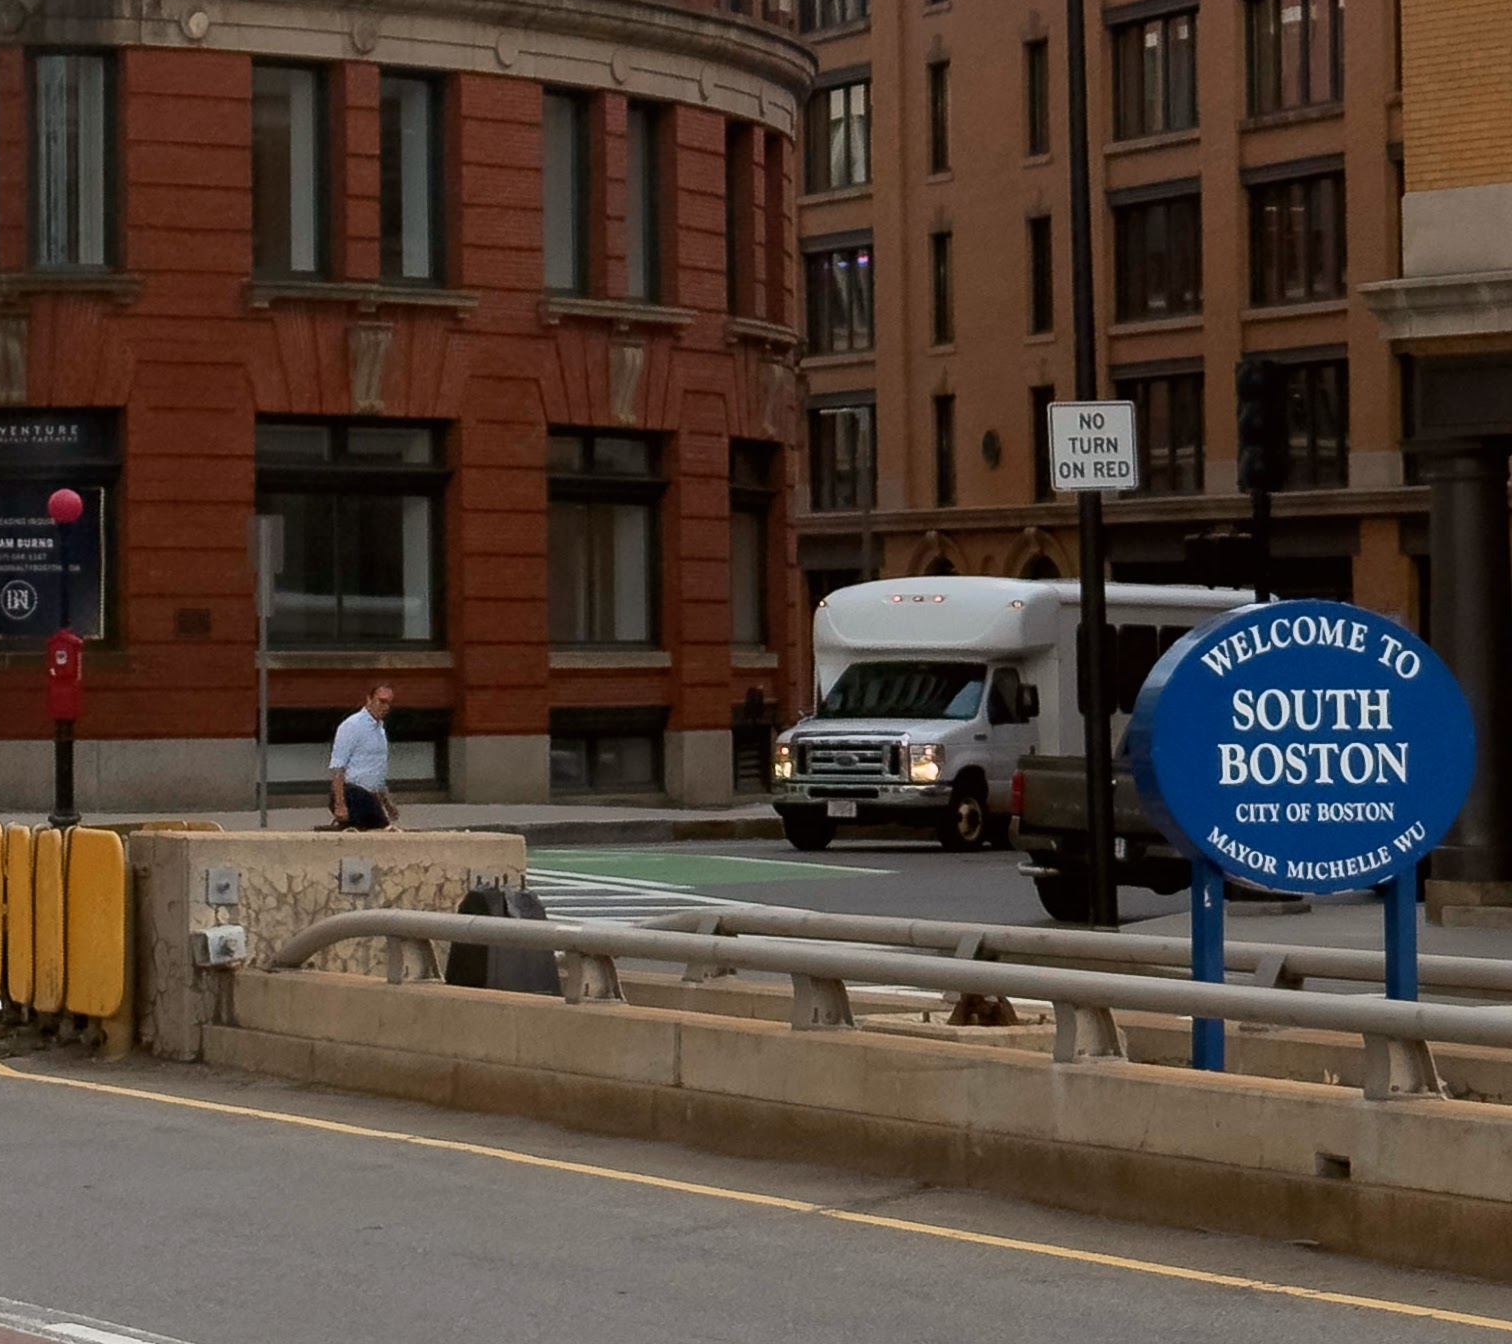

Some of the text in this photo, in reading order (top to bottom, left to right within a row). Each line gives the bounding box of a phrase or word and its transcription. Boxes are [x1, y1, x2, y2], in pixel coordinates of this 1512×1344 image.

[0, 425, 78, 435] VENTURE
[1079, 412, 1105, 430] NO
[1068, 437, 1118, 454] TURN
[1059, 460, 1130, 479] ON RED
[1201, 616, 1420, 679] WELCOME TO
[1232, 688, 1393, 731] SOUTH
[1218, 742, 1408, 784] BOSTON
[1236, 802, 1395, 822] CITY OF BOSTON
[1207, 820, 1426, 880] MAYOR MICHELLE WU
